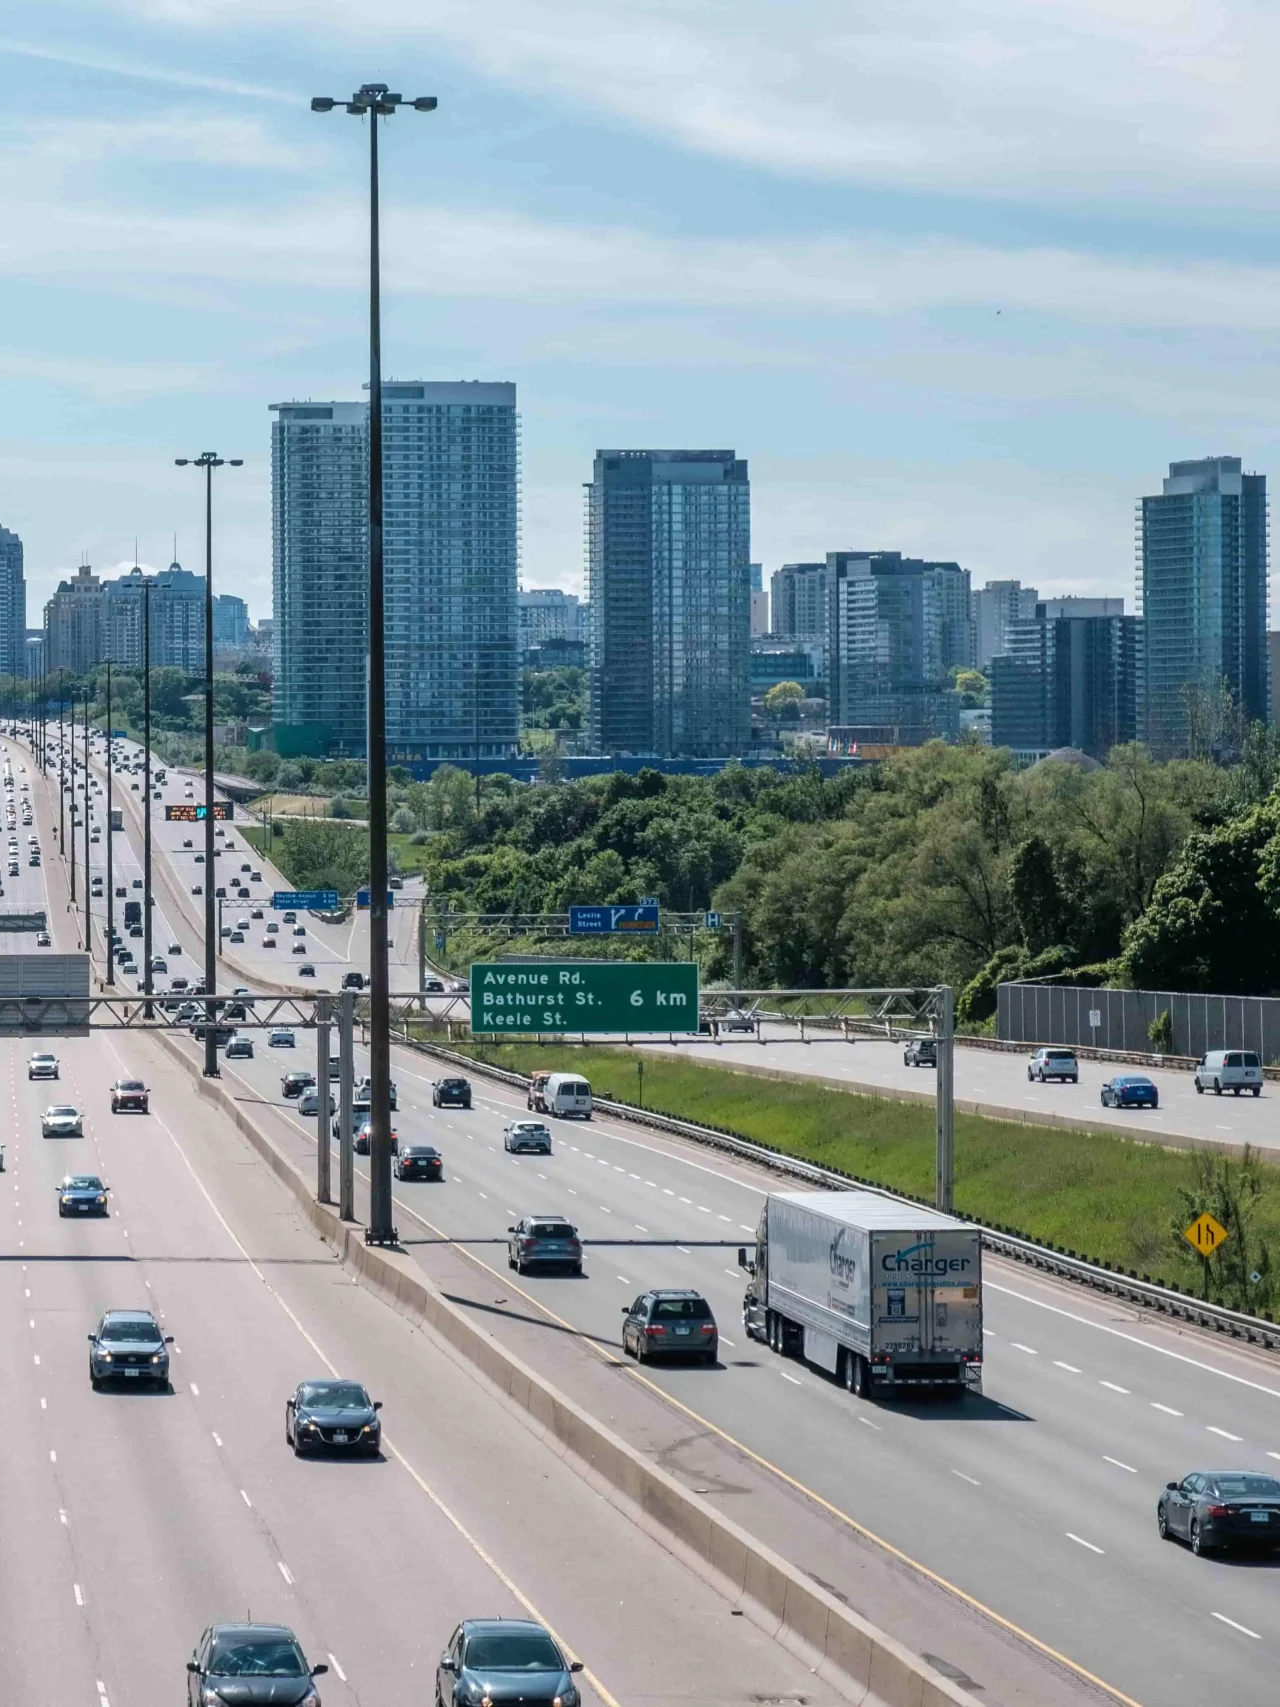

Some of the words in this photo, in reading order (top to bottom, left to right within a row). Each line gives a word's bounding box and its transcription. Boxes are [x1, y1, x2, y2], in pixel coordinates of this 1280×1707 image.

[708, 913, 718, 926] H
[483, 972, 549, 985] Avenue
[559, 972, 586, 985] Rd.
[483, 992, 564, 1005] Bathurst
[575, 992, 602, 1005] St.
[630, 990, 644, 1006] 6
[656, 990, 687, 1006] km
[483, 1012, 531, 1025] Keele
[543, 1012, 568, 1025] St.
[881, 1249, 971, 1276] Charger
